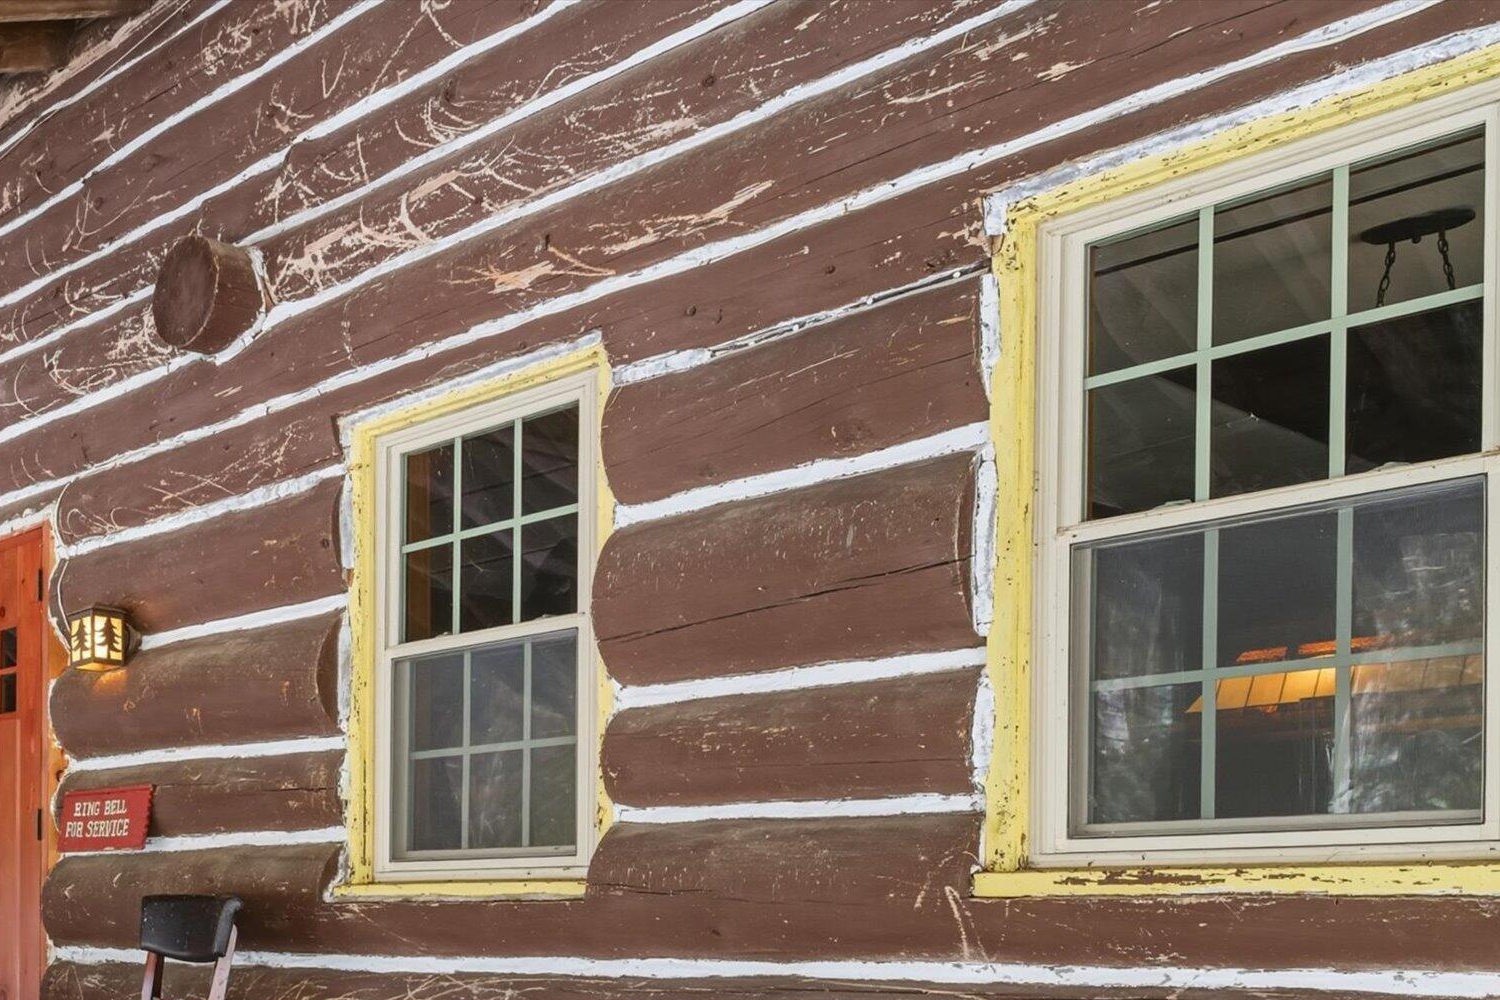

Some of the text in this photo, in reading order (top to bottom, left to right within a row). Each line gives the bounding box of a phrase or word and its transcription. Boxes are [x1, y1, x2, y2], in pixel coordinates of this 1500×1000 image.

[73, 799, 127, 817] RING BELL
[65, 819, 130, 838] FOR SERVICE
